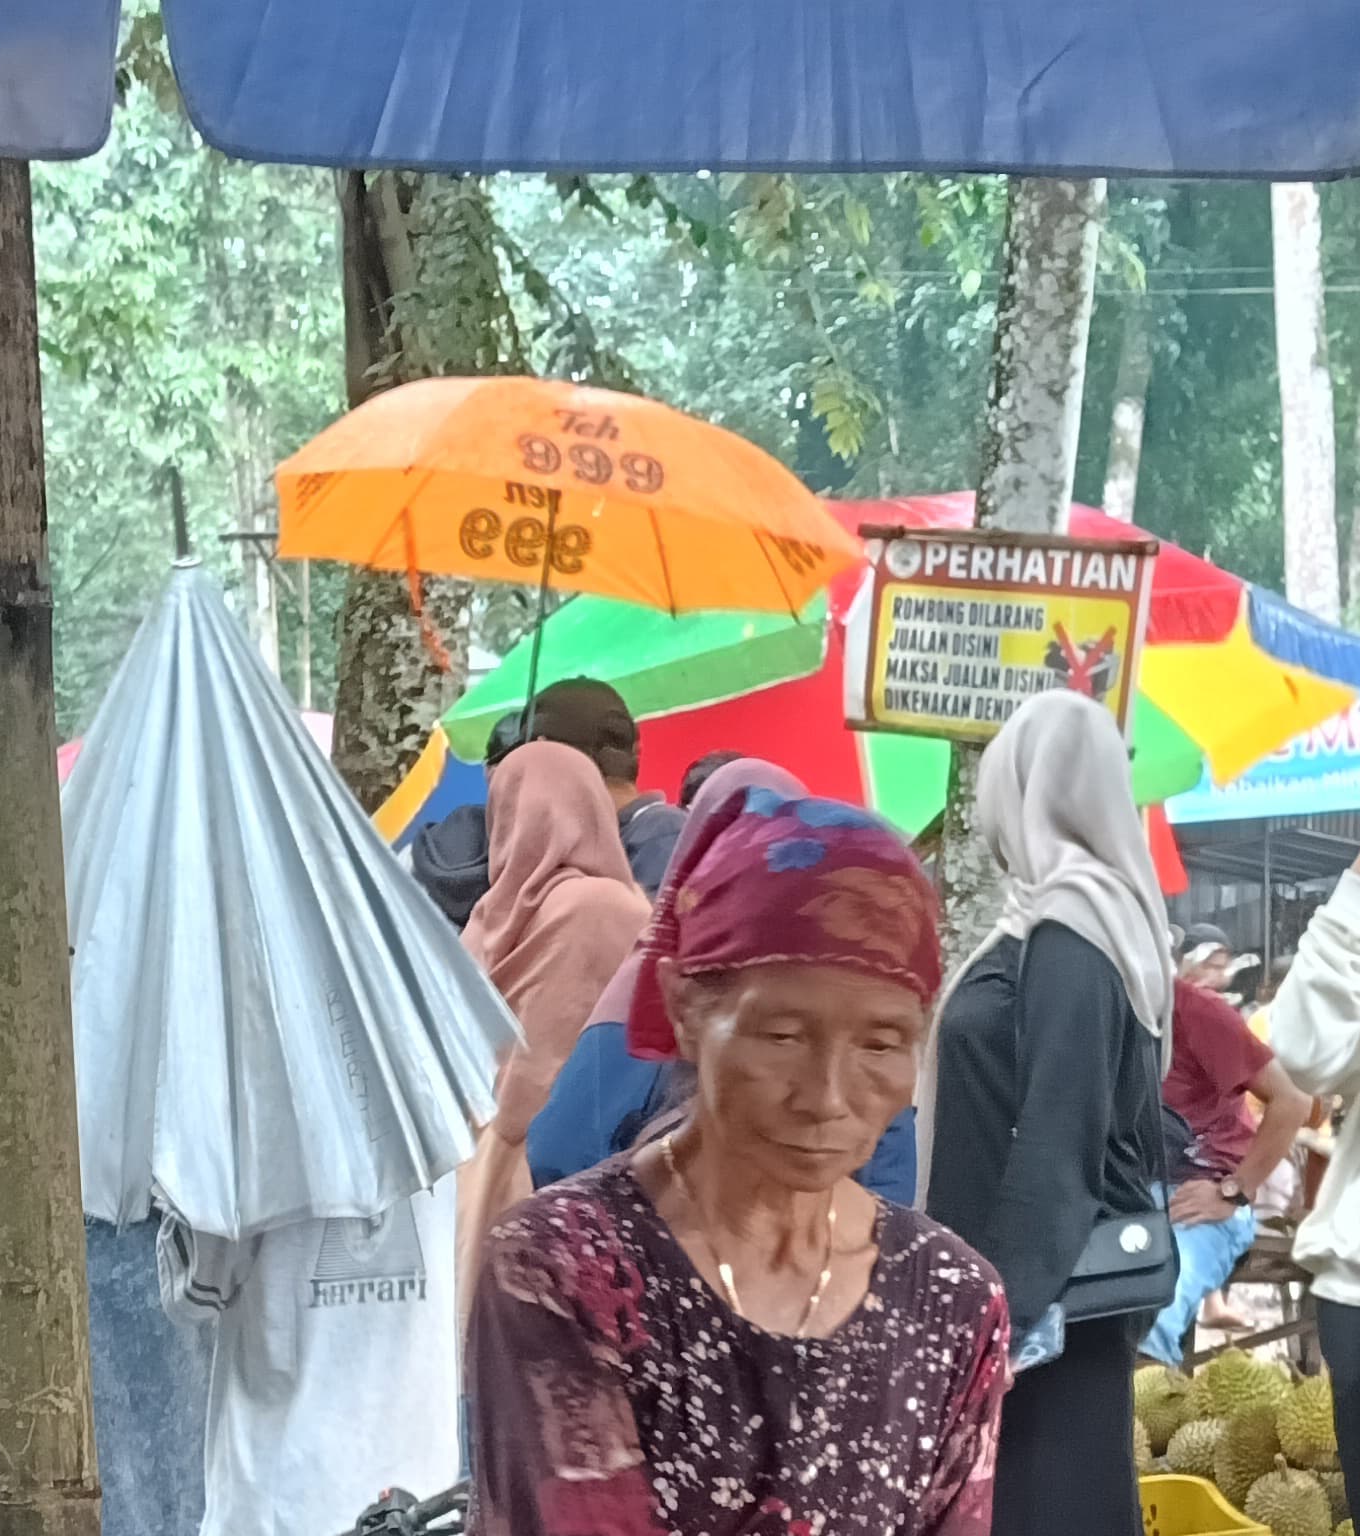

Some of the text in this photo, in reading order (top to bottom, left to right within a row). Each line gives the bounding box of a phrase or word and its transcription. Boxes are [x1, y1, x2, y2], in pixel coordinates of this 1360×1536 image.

[554, 409, 619, 440] Teh
[517, 433, 664, 494] 999
[924, 540, 1138, 592] PERHATIAN
[892, 596, 1045, 632] ROMBONG DILARANG
[888, 628, 1000, 659] JUALAN DISINI
[886, 657, 1055, 694] MAKSA JUALAN DISINI
[884, 688, 972, 719] DIKENAKAN
